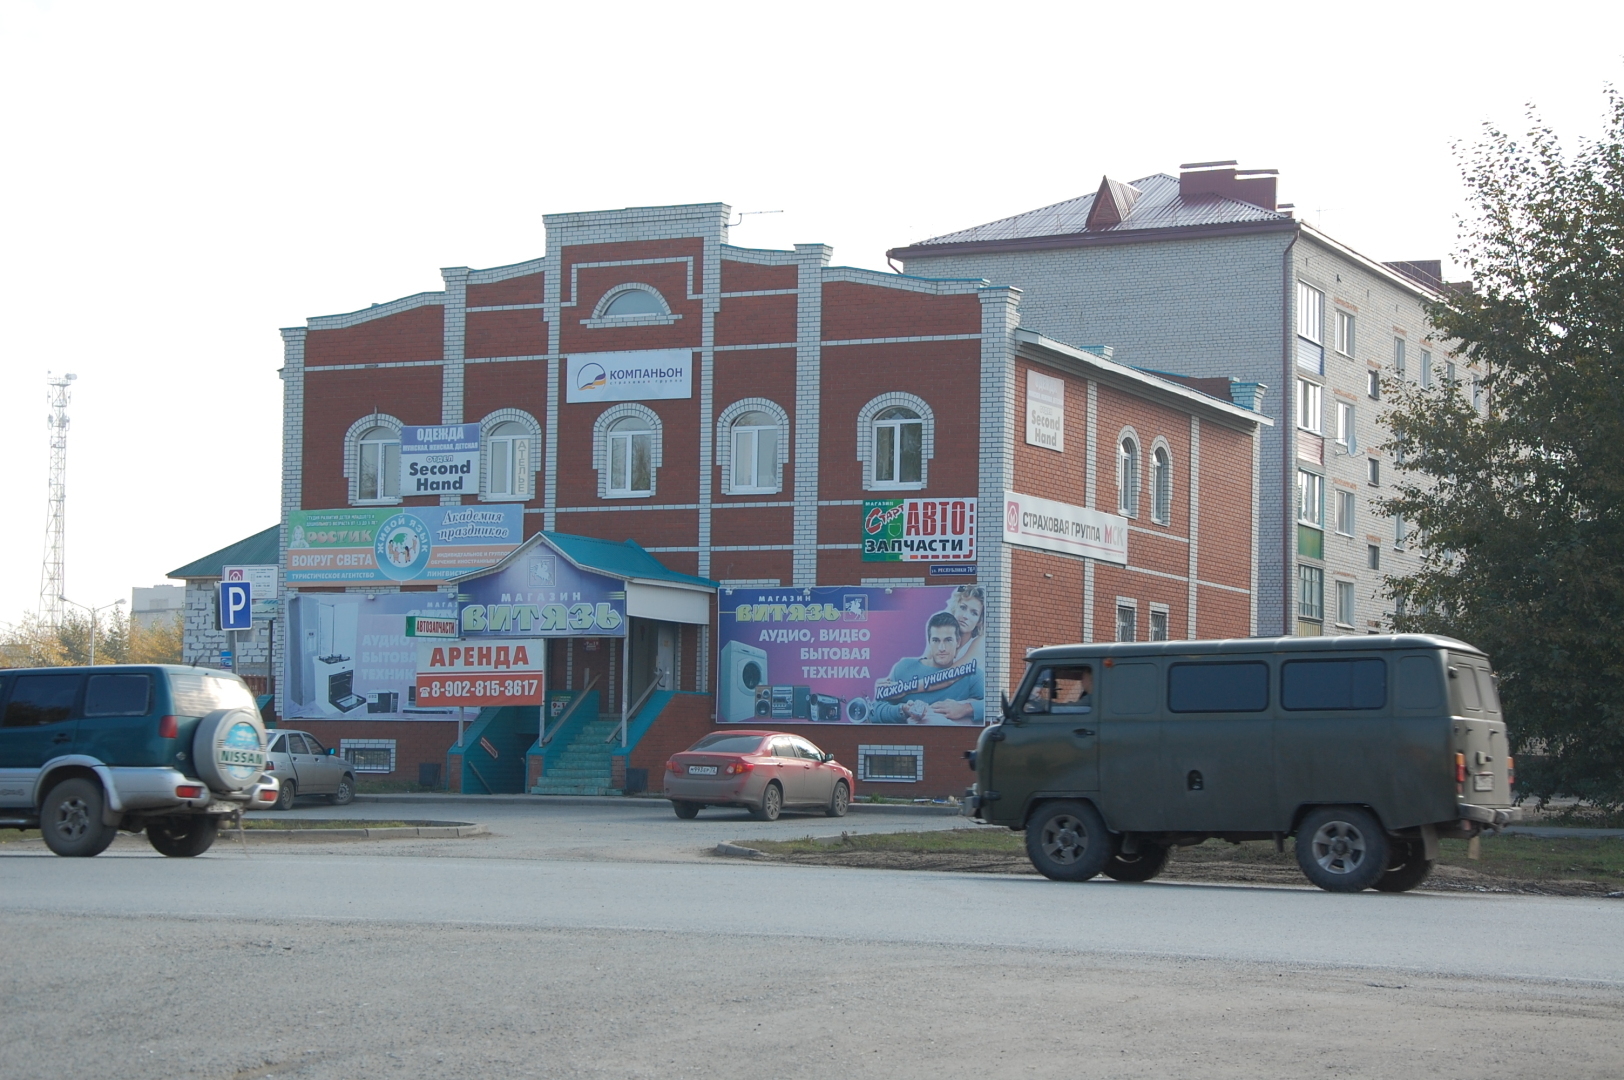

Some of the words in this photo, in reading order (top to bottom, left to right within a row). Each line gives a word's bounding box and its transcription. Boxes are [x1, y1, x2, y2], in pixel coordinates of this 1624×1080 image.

[609, 367, 683, 380] КОМПАНЬОН
[1031, 409, 1060, 431] Second
[416, 427, 464, 442] ОДЕЖДА
[1035, 427, 1057, 447] Hand
[409, 460, 471, 476] Second
[517, 441, 527, 493] АТЕЛЬЕ
[416, 476, 463, 491] Hand
[442, 508, 504, 525] Академия
[905, 501, 966, 536] АВТО
[306, 530, 373, 544] РОСТИК
[377, 515, 406, 554] ЖИВОЙ
[409, 519, 428, 553] ЯЗЫК
[437, 523, 509, 542] праздников
[1022, 511, 1070, 535] СТРАХОВАЯ
[1071, 521, 1101, 542] ГРУППА
[1104, 523, 1124, 547] МСК
[864, 539, 964, 553] ЗАПЧАСТИ
[292, 554, 334, 567] ВОКРУГ
[336, 554, 373, 566] СВЕТА
[229, 586, 246, 624] P
[501, 592, 581, 602] МАГАЗИН
[461, 603, 623, 632] ВИТЯЗЬ
[735, 604, 841, 623] ВИТЯЗЬ
[416, 620, 455, 634] АВТОЗАПЧАСТИ
[361, 634, 415, 648] АУДИО,
[759, 629, 815, 644] АУДИО,
[819, 628, 871, 643] ВИДЕО
[361, 651, 417, 663] БЫТОВА
[429, 645, 529, 669] АРЕНДА
[800, 647, 870, 660] БЫТОВАЯ
[361, 668, 415, 680] ТЕХНИК
[802, 666, 870, 679] ТЕХНИКА
[876, 676, 918, 700] Каждый
[922, 660, 977, 689] уникален!
[431, 679, 538, 697] 8-902-815-3617
[220, 750, 263, 764] NISSAN
